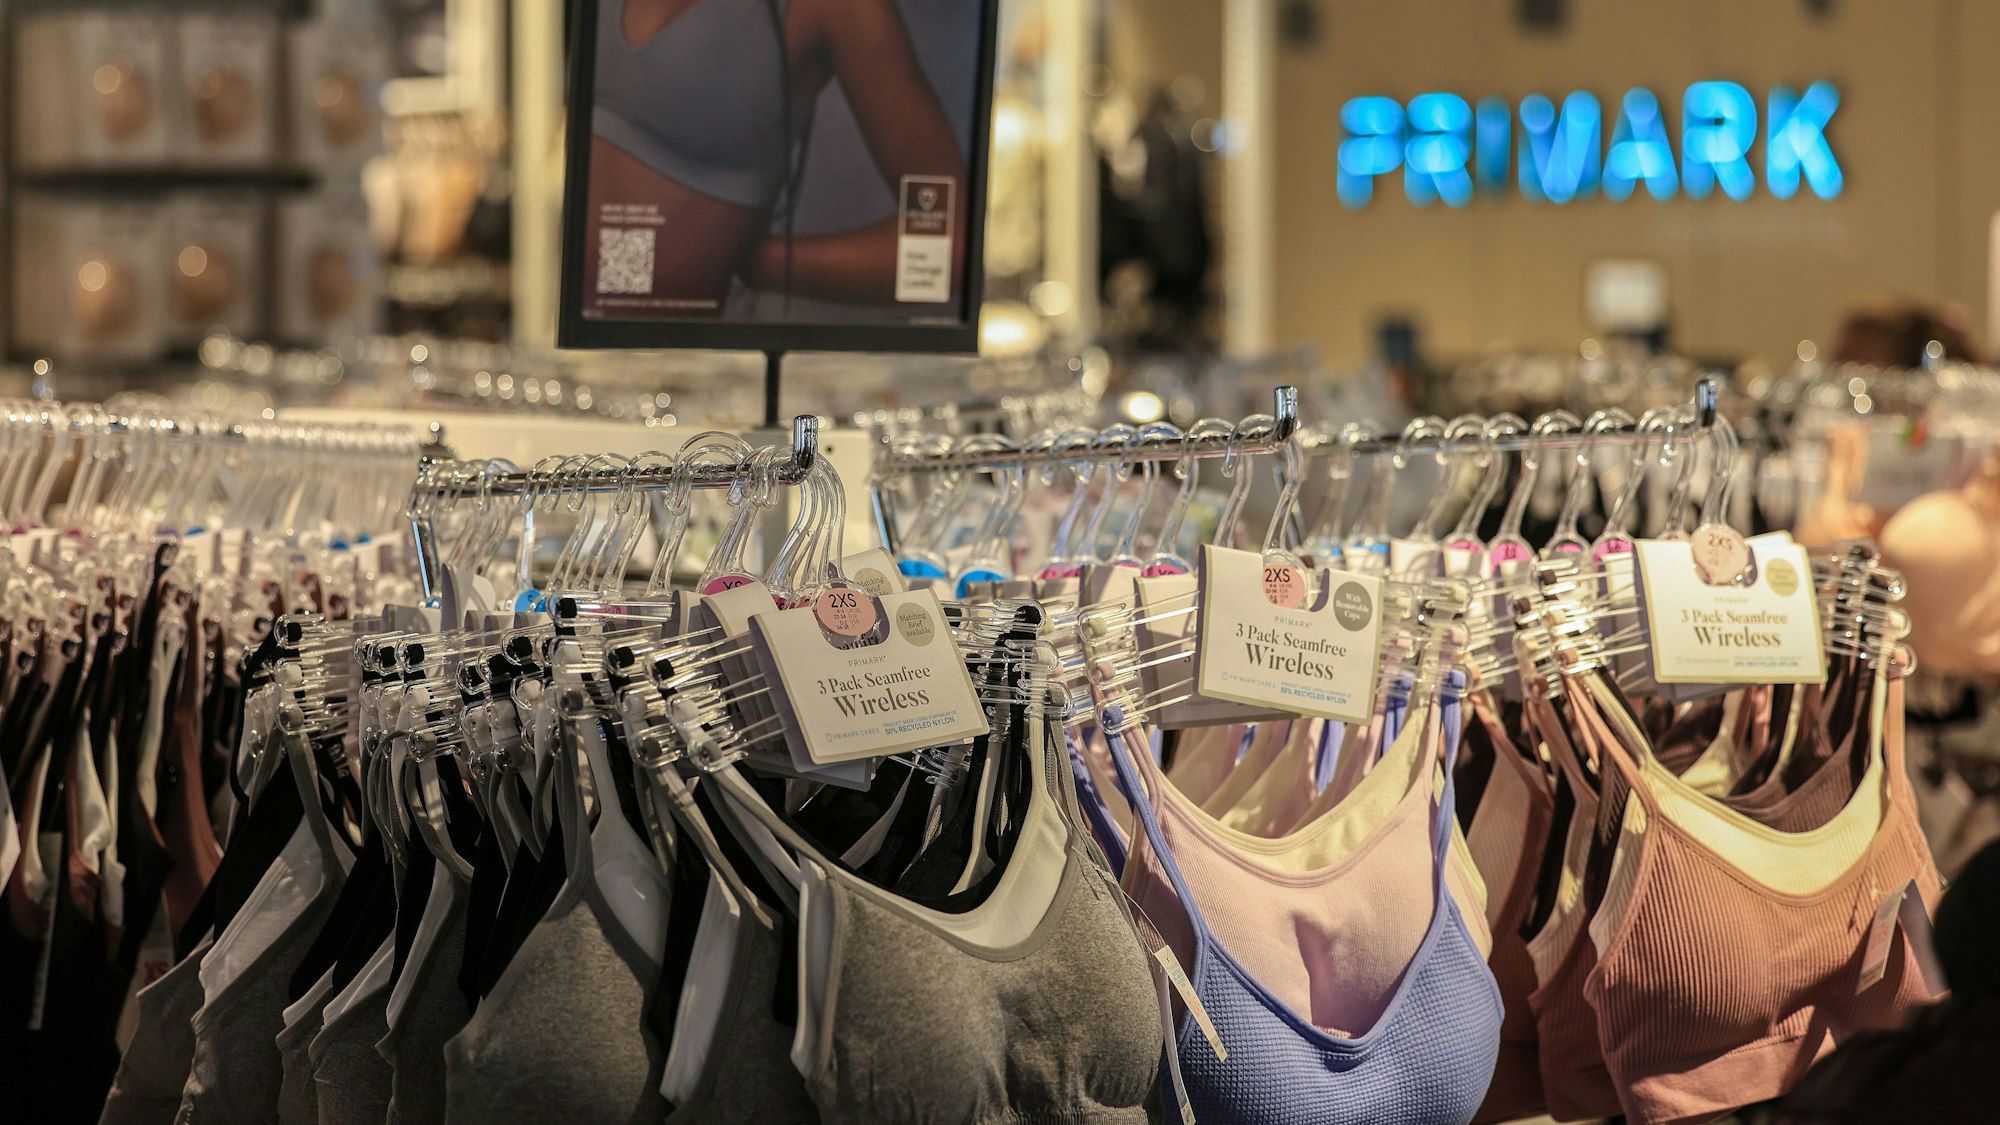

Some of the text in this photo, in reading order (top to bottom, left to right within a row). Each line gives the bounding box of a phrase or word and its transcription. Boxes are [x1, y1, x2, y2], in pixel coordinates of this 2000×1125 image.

[1337, 79, 1844, 210] PRIMARK
[1264, 568, 1290, 583] 2XS
[828, 593, 857, 608] 2XS
[1345, 592, 1361, 603] With
[1335, 599, 1370, 613] Removable
[899, 612, 927, 622] Matching
[1344, 610, 1361, 621] Cups
[1681, 609, 1788, 625] 3 Pack Seamfree
[905, 627, 931, 637] Available
[907, 620, 922, 629] Brief
[1236, 623, 1347, 658] 3 Pack Seamfree
[1693, 626, 1782, 648] Wireless
[1245, 642, 1334, 681] Wireless
[816, 665, 931, 695] 3 Pack Seamfree
[834, 687, 931, 719] Wireless
[1293, 689, 1325, 701] RECYCLED
[1325, 694, 1347, 704] NYLON
[860, 727, 880, 737] CARES
[885, 716, 955, 736] 50% RECYCLED NYLON
